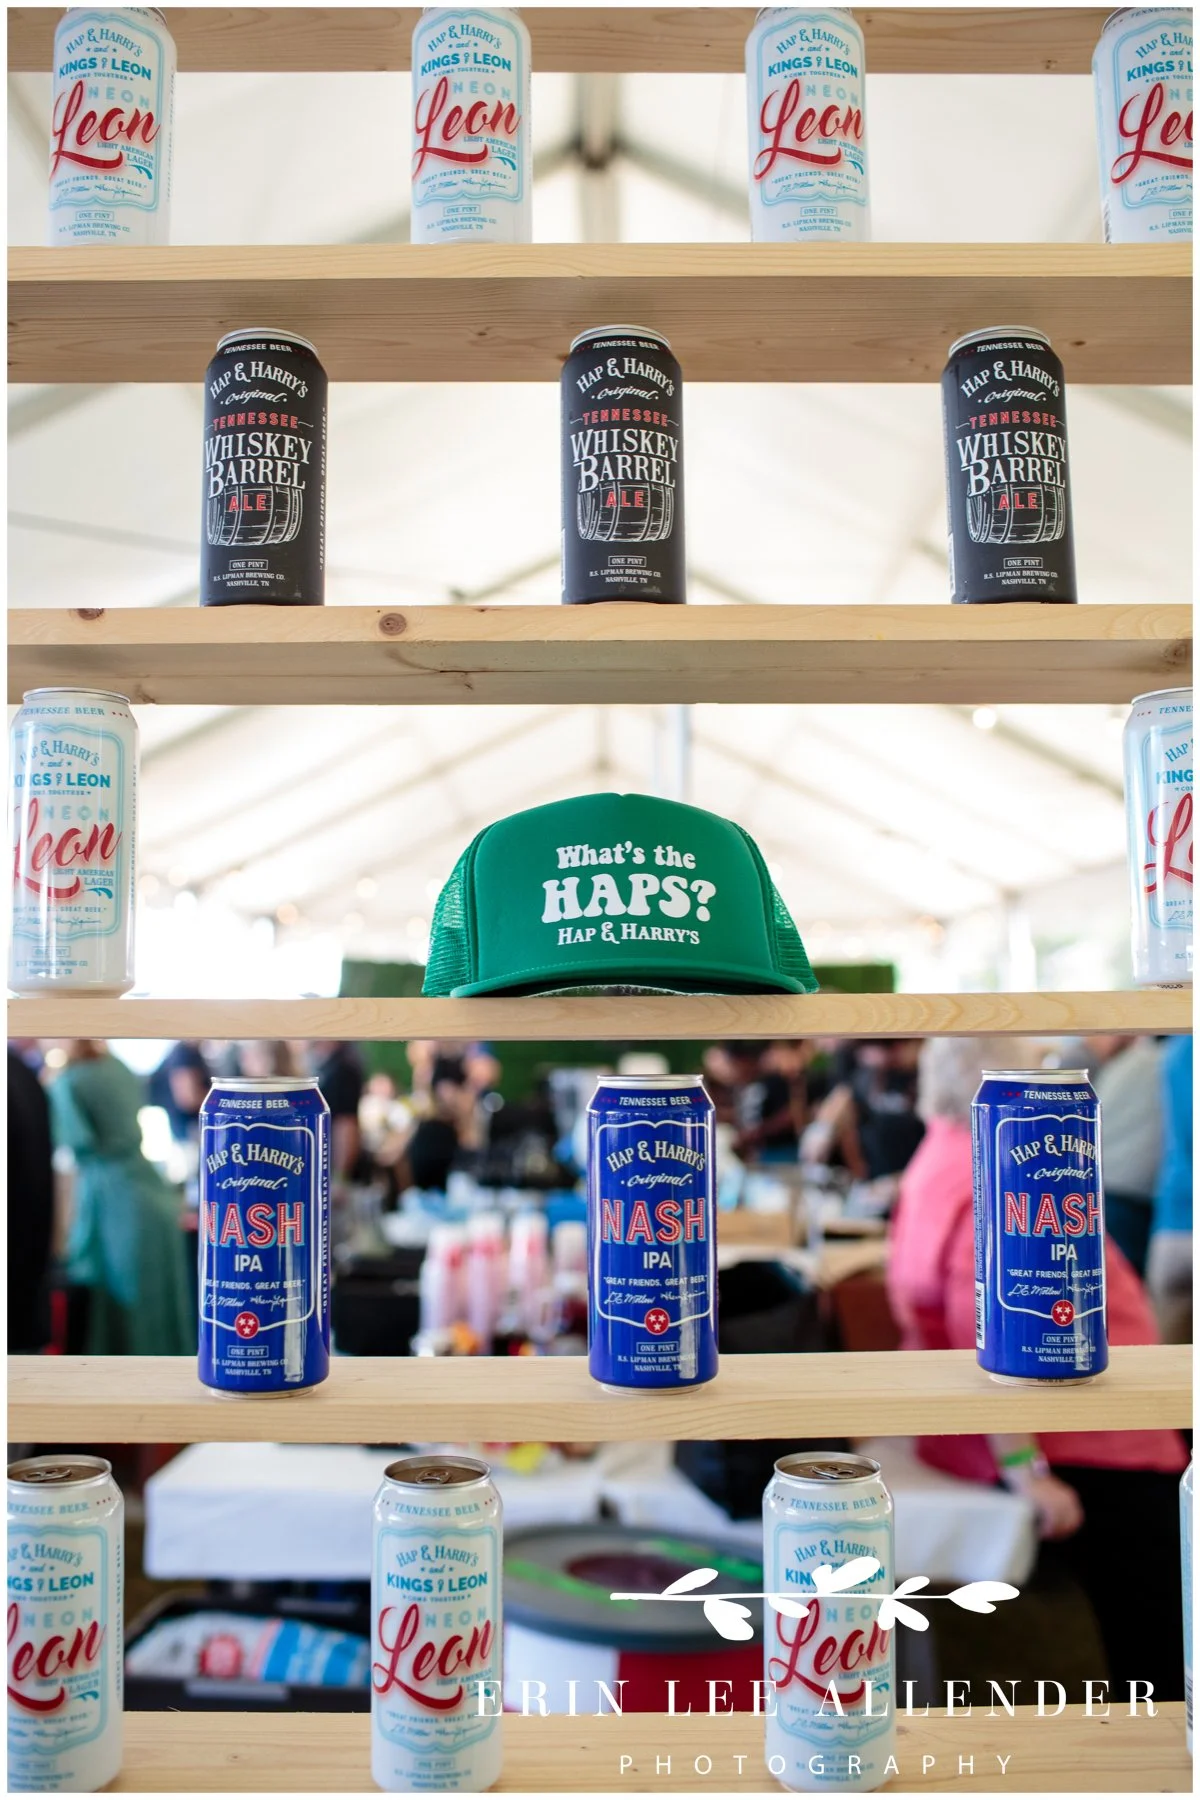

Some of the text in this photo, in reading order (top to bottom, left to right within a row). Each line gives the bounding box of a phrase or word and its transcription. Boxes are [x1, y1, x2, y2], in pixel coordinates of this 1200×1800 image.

[66, 28, 143, 57] HAP & HARRY'S
[428, 24, 502, 52] HAP & HARRY'S
[776, 28, 850, 56] HAP & HARRY'S
[1135, 32, 1174, 58] HAP &
[59, 57, 151, 80] KINGS LEON
[420, 52, 511, 76] KINGS LEON
[768, 56, 858, 78] KINGS LEON
[1126, 60, 1175, 82] KINGS
[87, 87, 149, 109] NEON
[453, 81, 511, 100] NEON
[806, 84, 858, 106] NEON
[50, 80, 160, 181] Leon
[412, 76, 521, 181] Leon
[754, 78, 863, 180] Leon
[224, 343, 293, 354] TENNESSEE BEER
[593, 340, 660, 351] TENNESSEE BEER
[977, 342, 1046, 352] TENNESSEE BEER
[210, 361, 309, 399] HAP & HARRY'S
[576, 357, 675, 397] HAP & HARRY'S
[960, 360, 1060, 399] HAP & HARRY'S
[225, 389, 287, 405] Original
[597, 386, 658, 400] Original
[984, 388, 1047, 403] Original
[213, 412, 299, 430] TENNESSEE
[582, 409, 668, 427] TENNESSEE
[969, 410, 1057, 429] TENNESSEE
[205, 432, 312, 469] WHISKEY
[570, 429, 679, 463] WHISKEY
[956, 430, 1066, 468] WHISKEY
[206, 458, 305, 499] BARREL
[573, 455, 676, 493] BARREL
[961, 457, 1066, 497] BARREL
[229, 494, 267, 512] ALE
[606, 490, 645, 507] ALE
[998, 493, 1038, 510] ALE
[222, 572, 245, 580] LIPMAN
[232, 561, 246, 569] ONE
[75, 707, 105, 716] BEER
[40, 740, 100, 767] & HARRY'S
[1164, 742, 1189, 762] HAP
[66, 773, 110, 788] LEON
[43, 805, 110, 822] NEON
[556, 841, 696, 870] What's the
[541, 872, 716, 924] HAPS?
[558, 921, 700, 946] HAP & HARRY'S
[218, 1098, 290, 1109] TENNESSEE BEER
[619, 1096, 692, 1107] TENNESSEE BEER
[1023, 1090, 1091, 1101] TENNESSEE BEER
[206, 1143, 305, 1175] HAP & HARRY'S
[606, 1140, 706, 1172] HAP & HARRY'S
[1010, 1134, 1062, 1166] HAP &
[221, 1175, 288, 1193] Original
[627, 1173, 693, 1189] Original
[1033, 1167, 1093, 1182] Original
[201, 1199, 305, 1248] NASH
[601, 1198, 706, 1246] NASH
[1004, 1191, 1102, 1238] NASH
[643, 1251, 672, 1269] IPA
[1051, 1243, 1078, 1261] IPA
[234, 1254, 263, 1273] IPA
[1035, 1269, 1090, 1279] FRIENDS. GREAT
[221, 1280, 280, 1290] FRIENDS. GREAT
[628, 1276, 687, 1287] FRIENDS. GREAT
[640, 1343, 675, 1352] ONE PINT
[1034, 1346, 1060, 1354] LIPMAN
[1046, 1335, 1079, 1343] ONE PINT
[630, 1355, 657, 1363] LIPMAN
[394, 1502, 481, 1517] TENNESSEE BEER
[790, 1497, 878, 1512] TENNESSEE BEER
[396, 1544, 480, 1568] HAP & HARRY'S
[794, 1539, 835, 1563] HAP &
[48, 1572, 94, 1592] LEON
[387, 1571, 488, 1593] KINGS LEON
[23, 1606, 93, 1628] NEON
[425, 1606, 487, 1628] NEON
[373, 1603, 496, 1711] Leon
[769, 1598, 889, 1704] Leon
